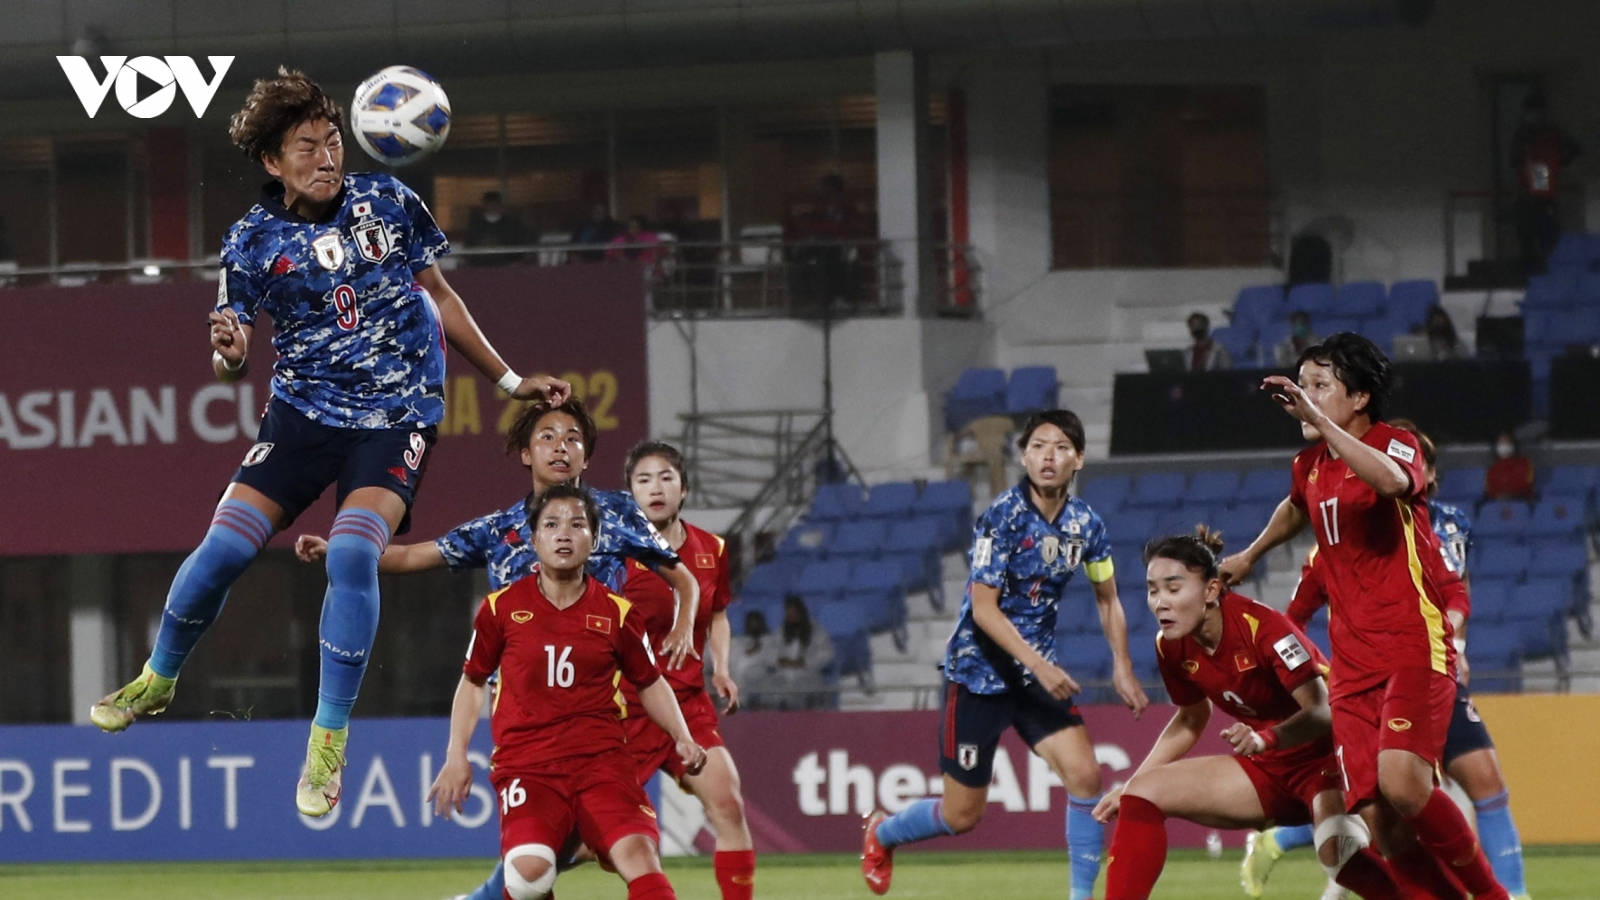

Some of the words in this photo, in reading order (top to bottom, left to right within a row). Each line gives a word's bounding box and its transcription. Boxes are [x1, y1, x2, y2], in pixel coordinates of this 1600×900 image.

[333, 284, 360, 331] 9
[403, 432, 426, 470] 9
[1319, 496, 1340, 546] 17
[319, 638, 366, 658] JAPAN
[544, 645, 576, 688] 16
[298, 751, 494, 831] AIS
[500, 778, 527, 816] 16
